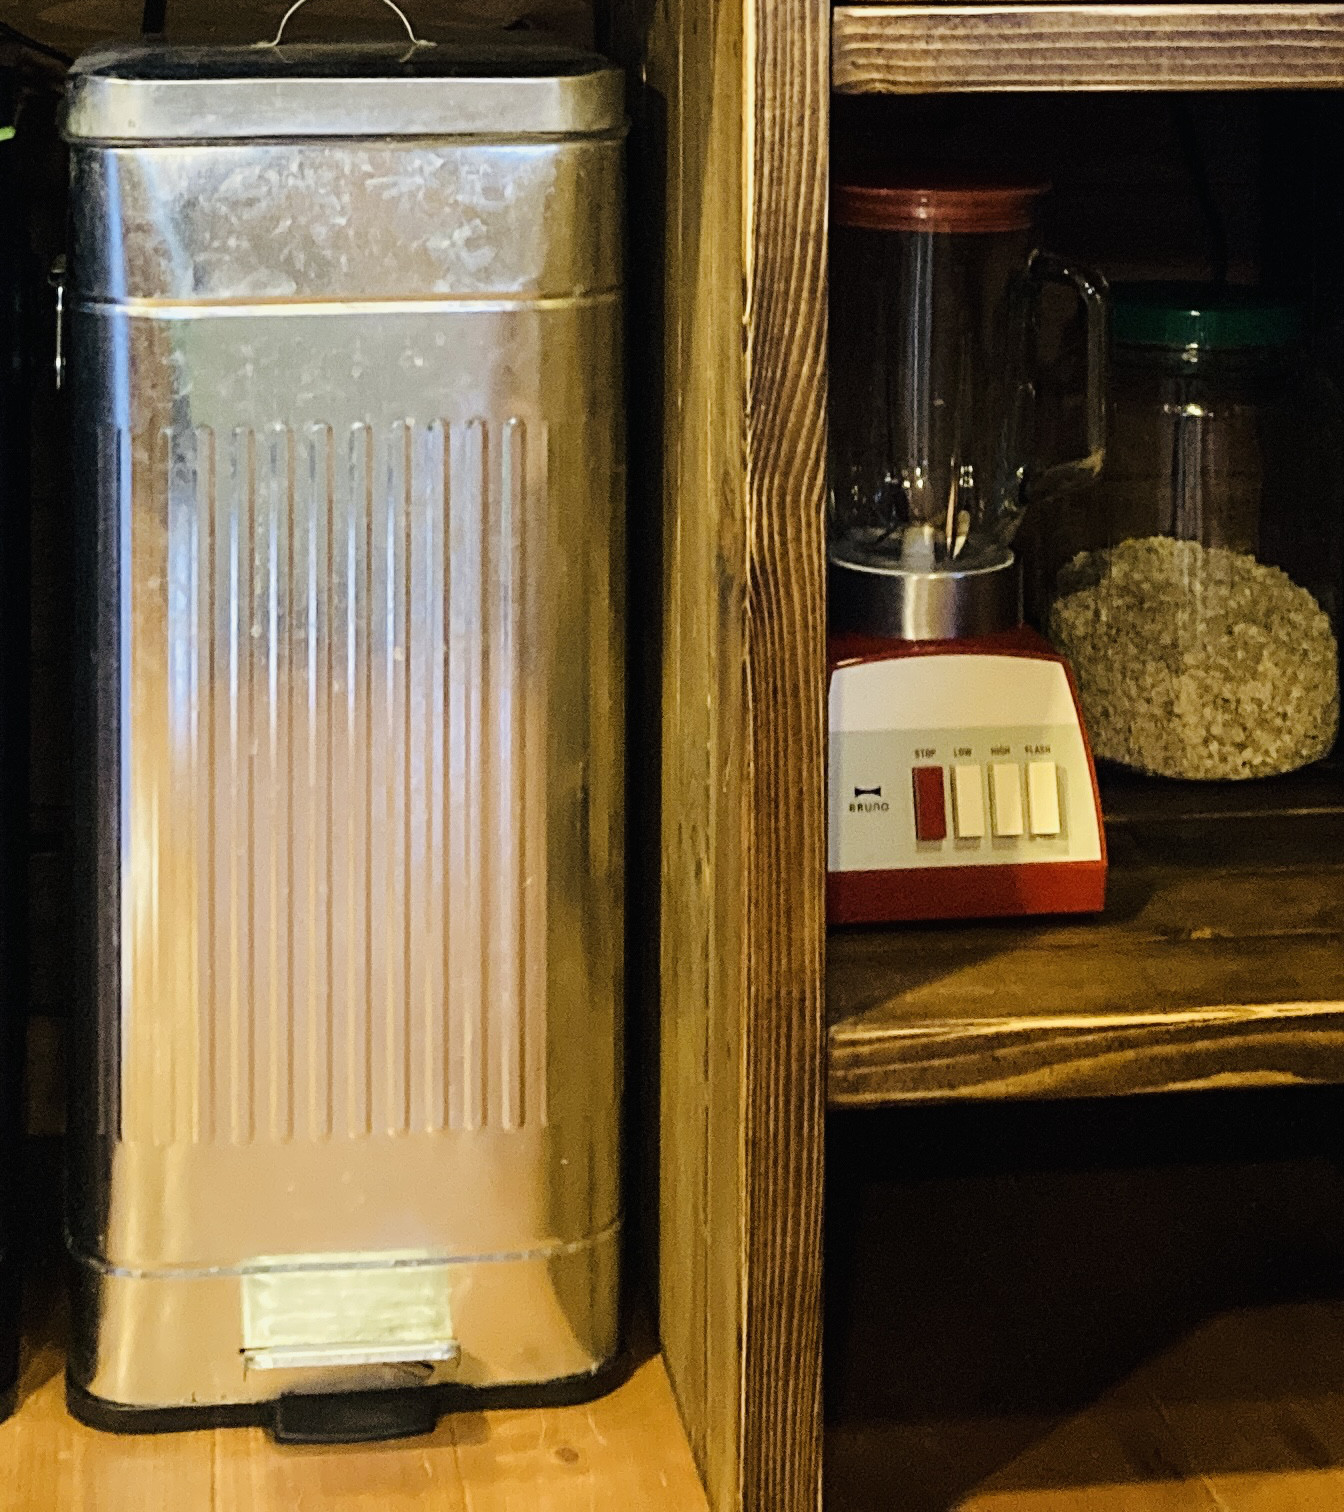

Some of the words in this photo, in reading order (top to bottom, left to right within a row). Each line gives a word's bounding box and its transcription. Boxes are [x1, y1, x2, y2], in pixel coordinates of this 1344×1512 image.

[914, 748, 937, 760] STOP
[953, 747, 973, 758] LOW
[990, 745, 1011, 756] HIGH
[848, 802, 890, 814] BRUNO
